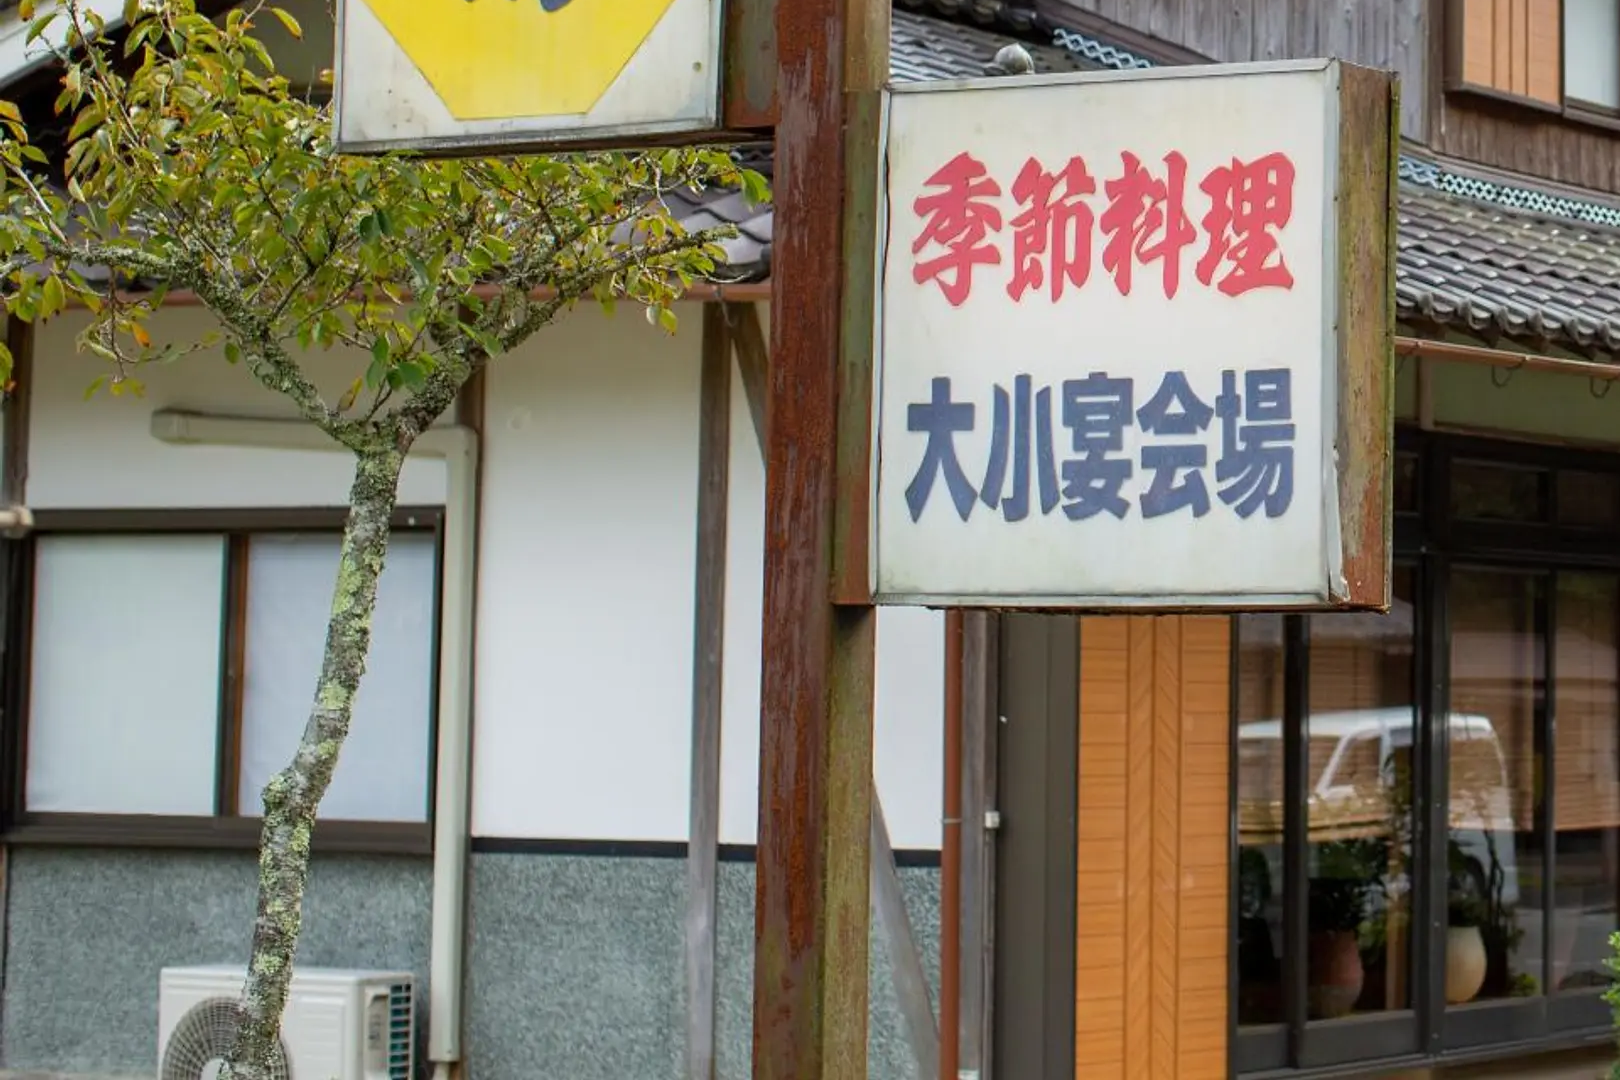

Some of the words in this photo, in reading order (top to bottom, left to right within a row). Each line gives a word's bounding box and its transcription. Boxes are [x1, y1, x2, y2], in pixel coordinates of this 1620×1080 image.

[912, 150, 1295, 306] 季節料理
[904, 368, 1295, 523] 大小宴会場
